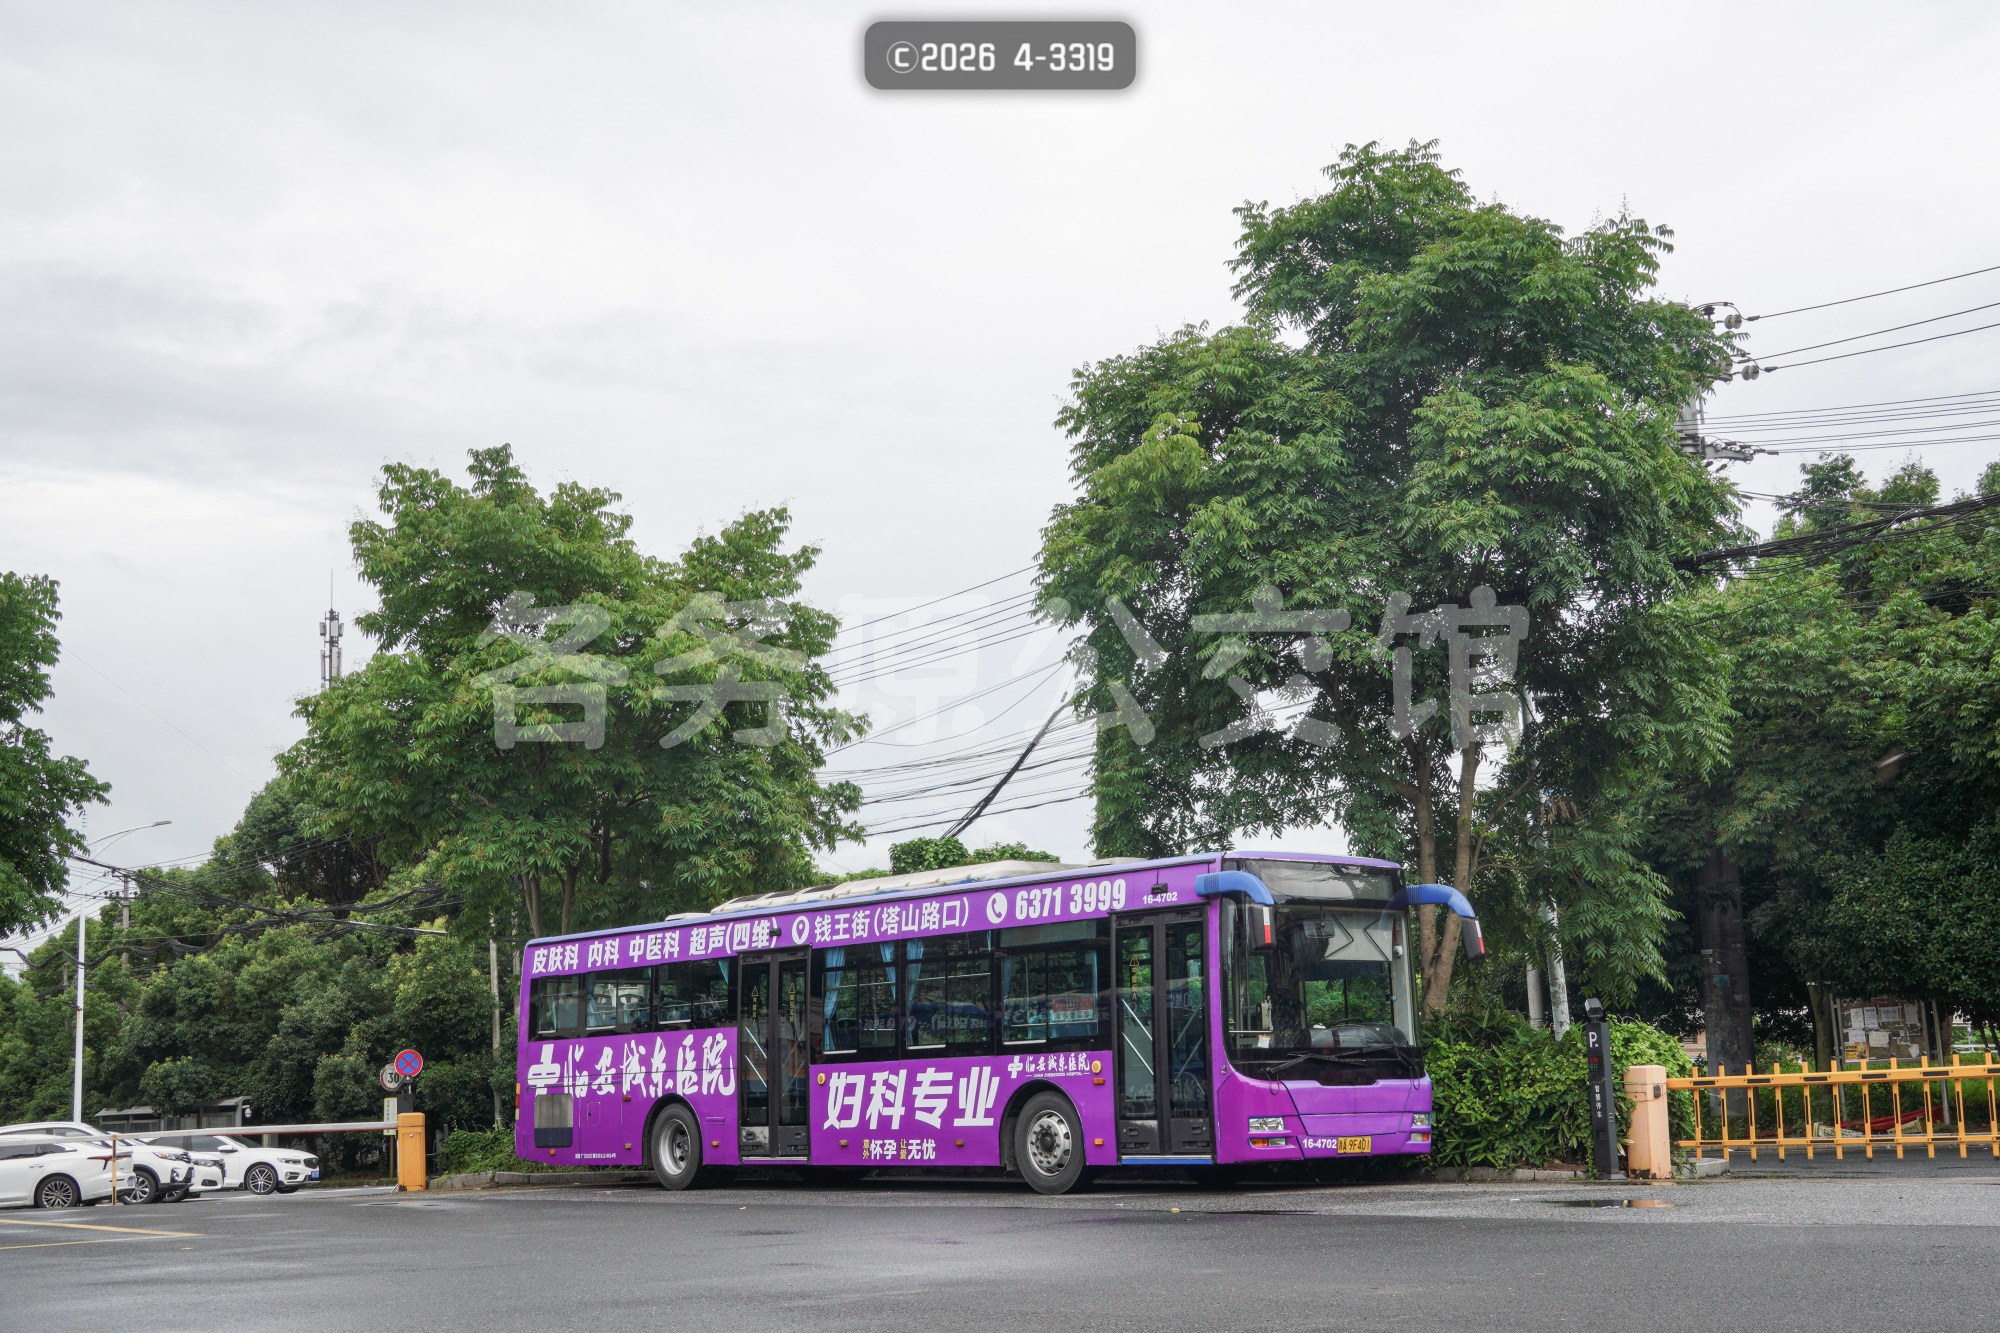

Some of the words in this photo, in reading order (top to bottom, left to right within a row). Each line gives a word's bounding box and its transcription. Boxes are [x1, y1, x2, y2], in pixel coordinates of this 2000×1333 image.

[1015, 886, 1062, 920] 6371
[1070, 879, 1127, 914] 3999
[1142, 891, 1178, 905] 16-4702
[814, 897, 970, 943] 钱王街(塔山路口)
[532, 943, 579, 974] 皮肤科
[587, 938, 620, 968] 内科
[629, 930, 680, 963] 中医科
[387, 1072, 400, 1084] 30
[823, 1066, 1001, 1130] 妇科专业
[1302, 1138, 1338, 1149] 16-4702
